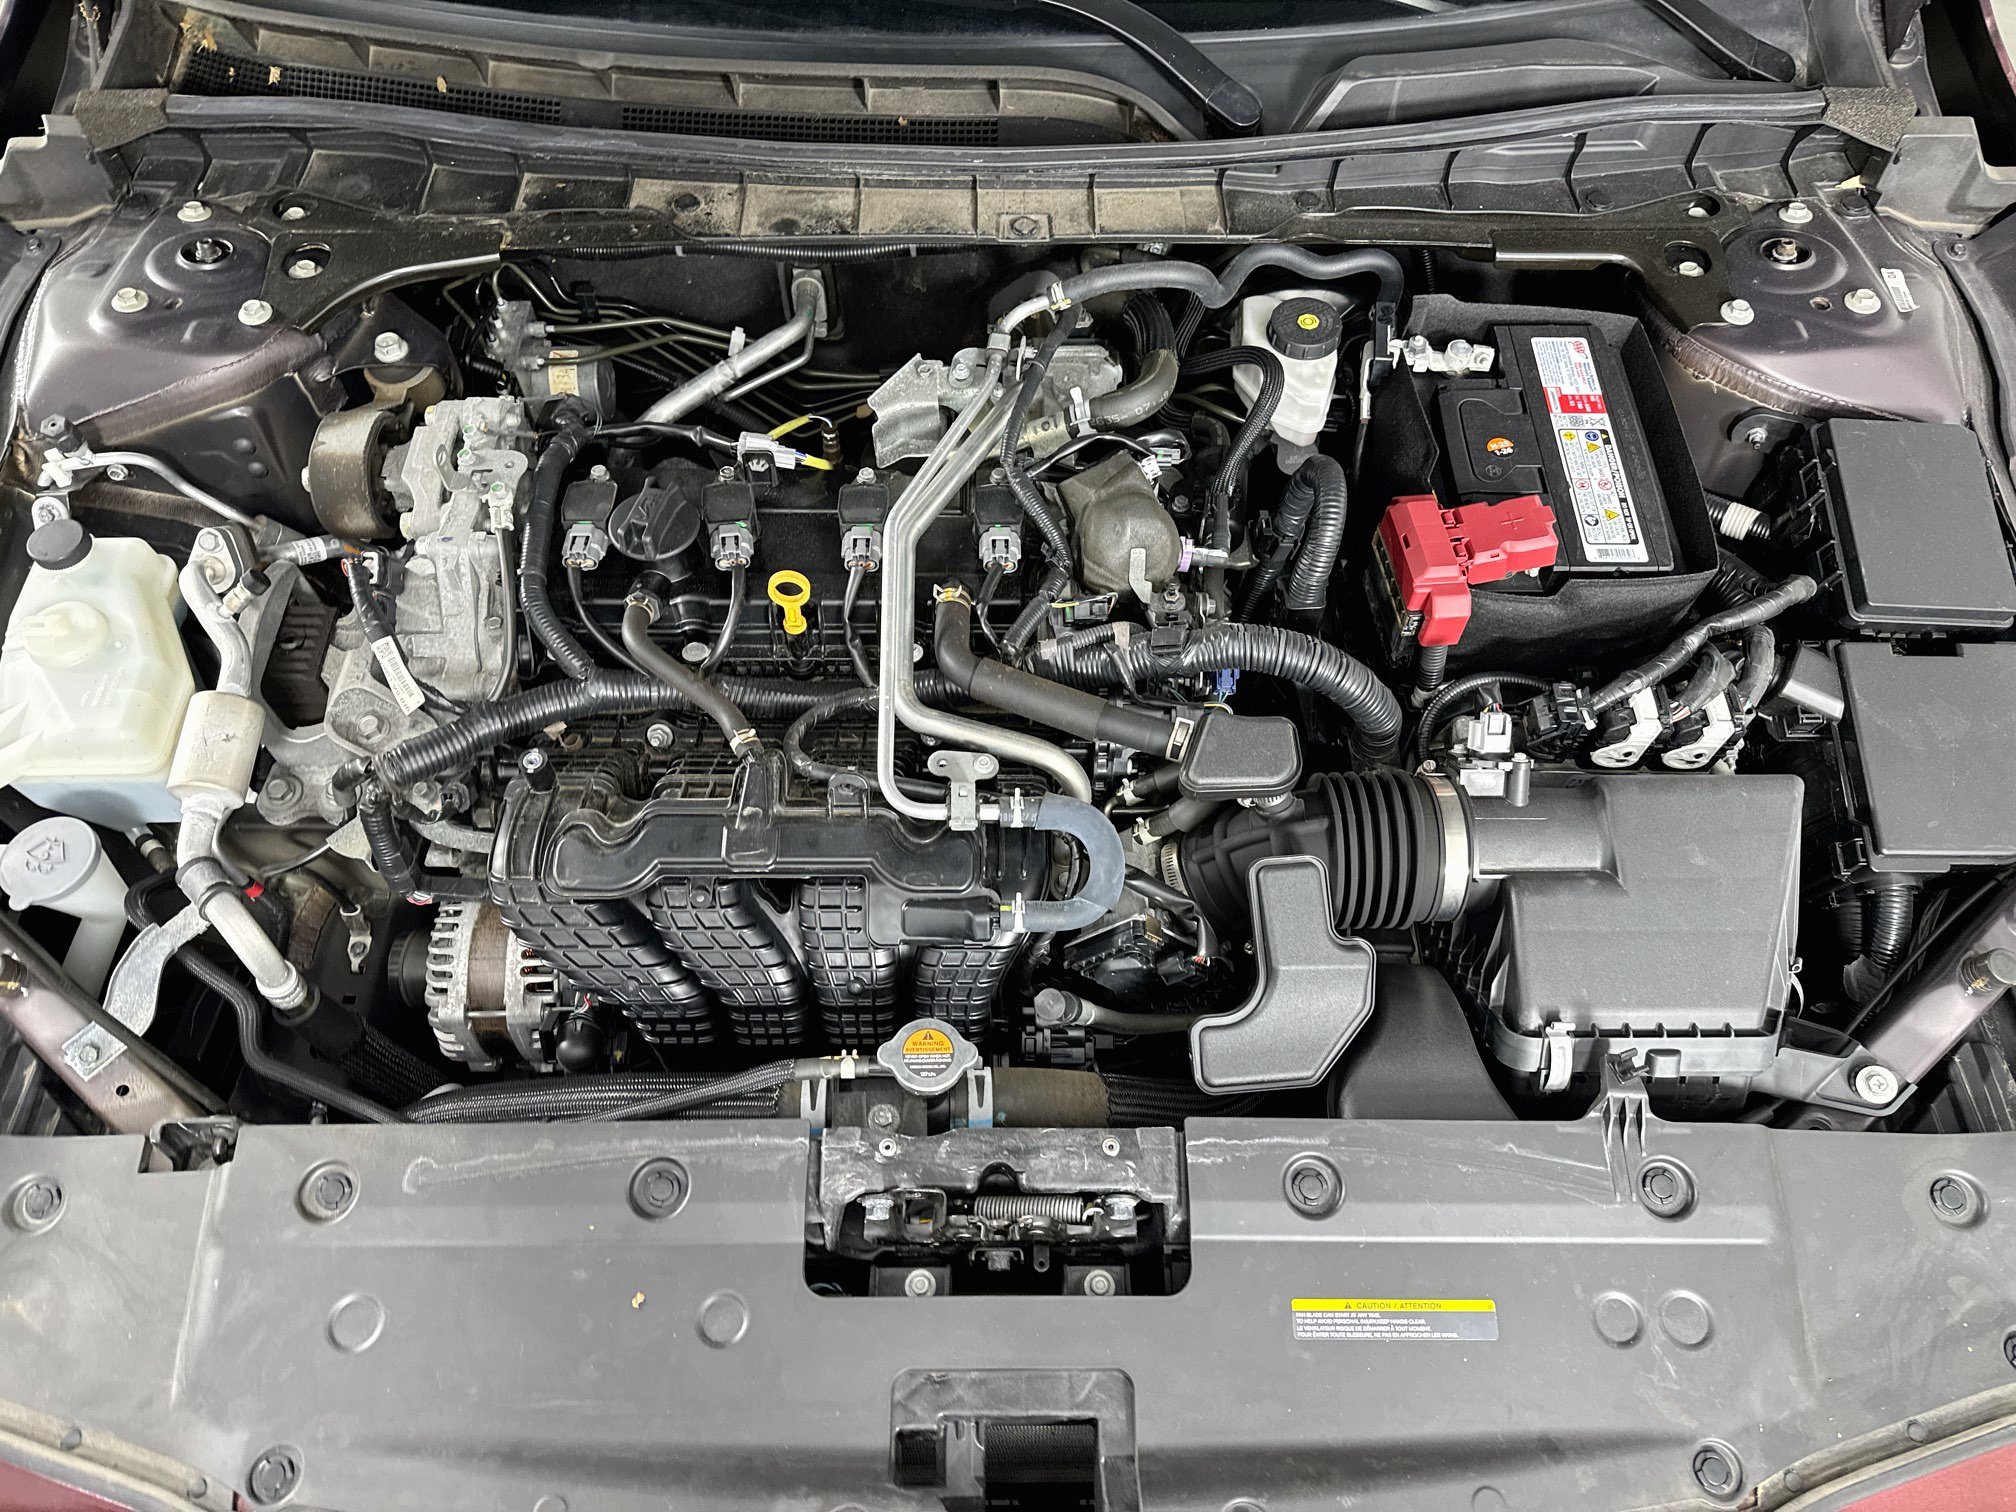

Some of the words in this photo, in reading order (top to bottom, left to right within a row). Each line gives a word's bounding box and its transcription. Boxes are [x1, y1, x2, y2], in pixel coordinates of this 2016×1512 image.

[1604, 444, 1626, 498] DANGER/POISON
[1356, 1302, 1391, 1310] CAUTION
[1362, 1324, 1390, 1332] DÉMARRER
